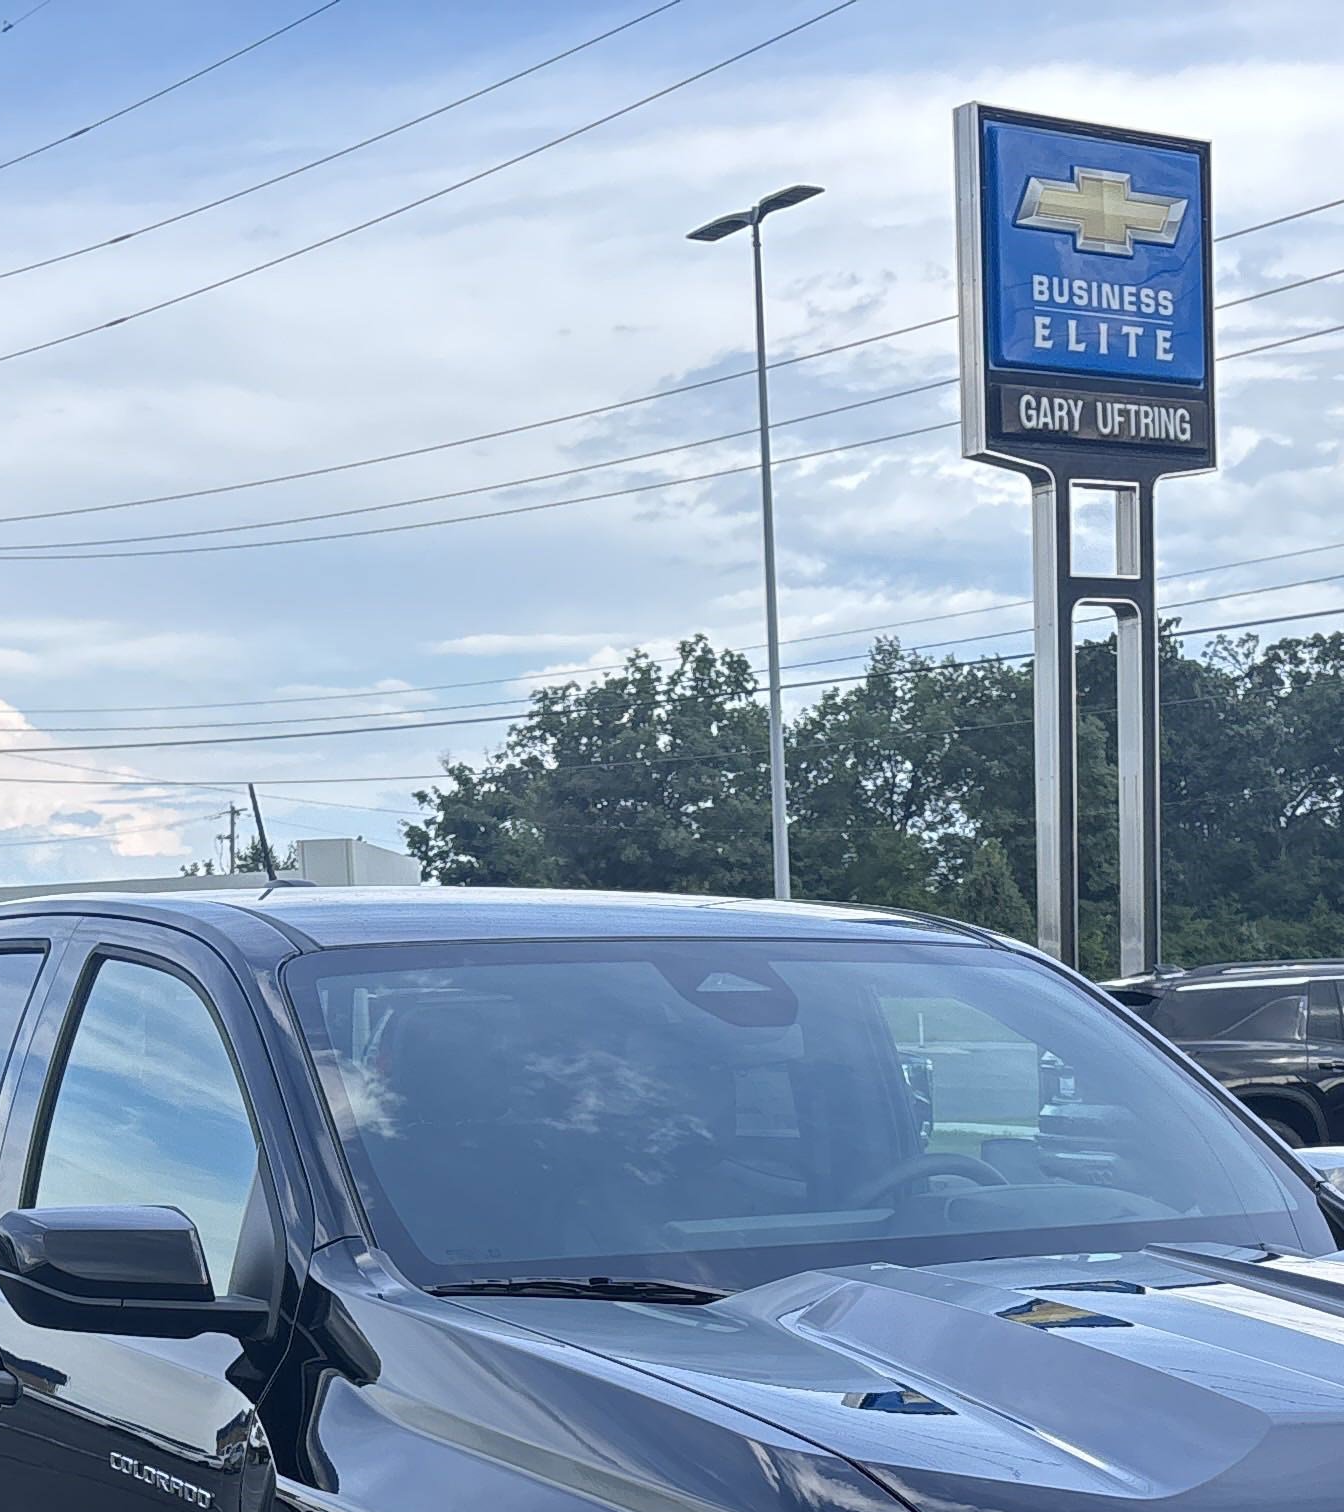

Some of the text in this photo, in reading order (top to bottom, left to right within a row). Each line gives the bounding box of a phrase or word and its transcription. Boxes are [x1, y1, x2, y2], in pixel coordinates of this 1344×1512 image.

[1032, 274, 1174, 316] BUSINESS
[1034, 316, 1175, 362] ELITE
[1019, 394, 1192, 442] GARY UFTRING
[109, 1451, 213, 1509] COLORADO
